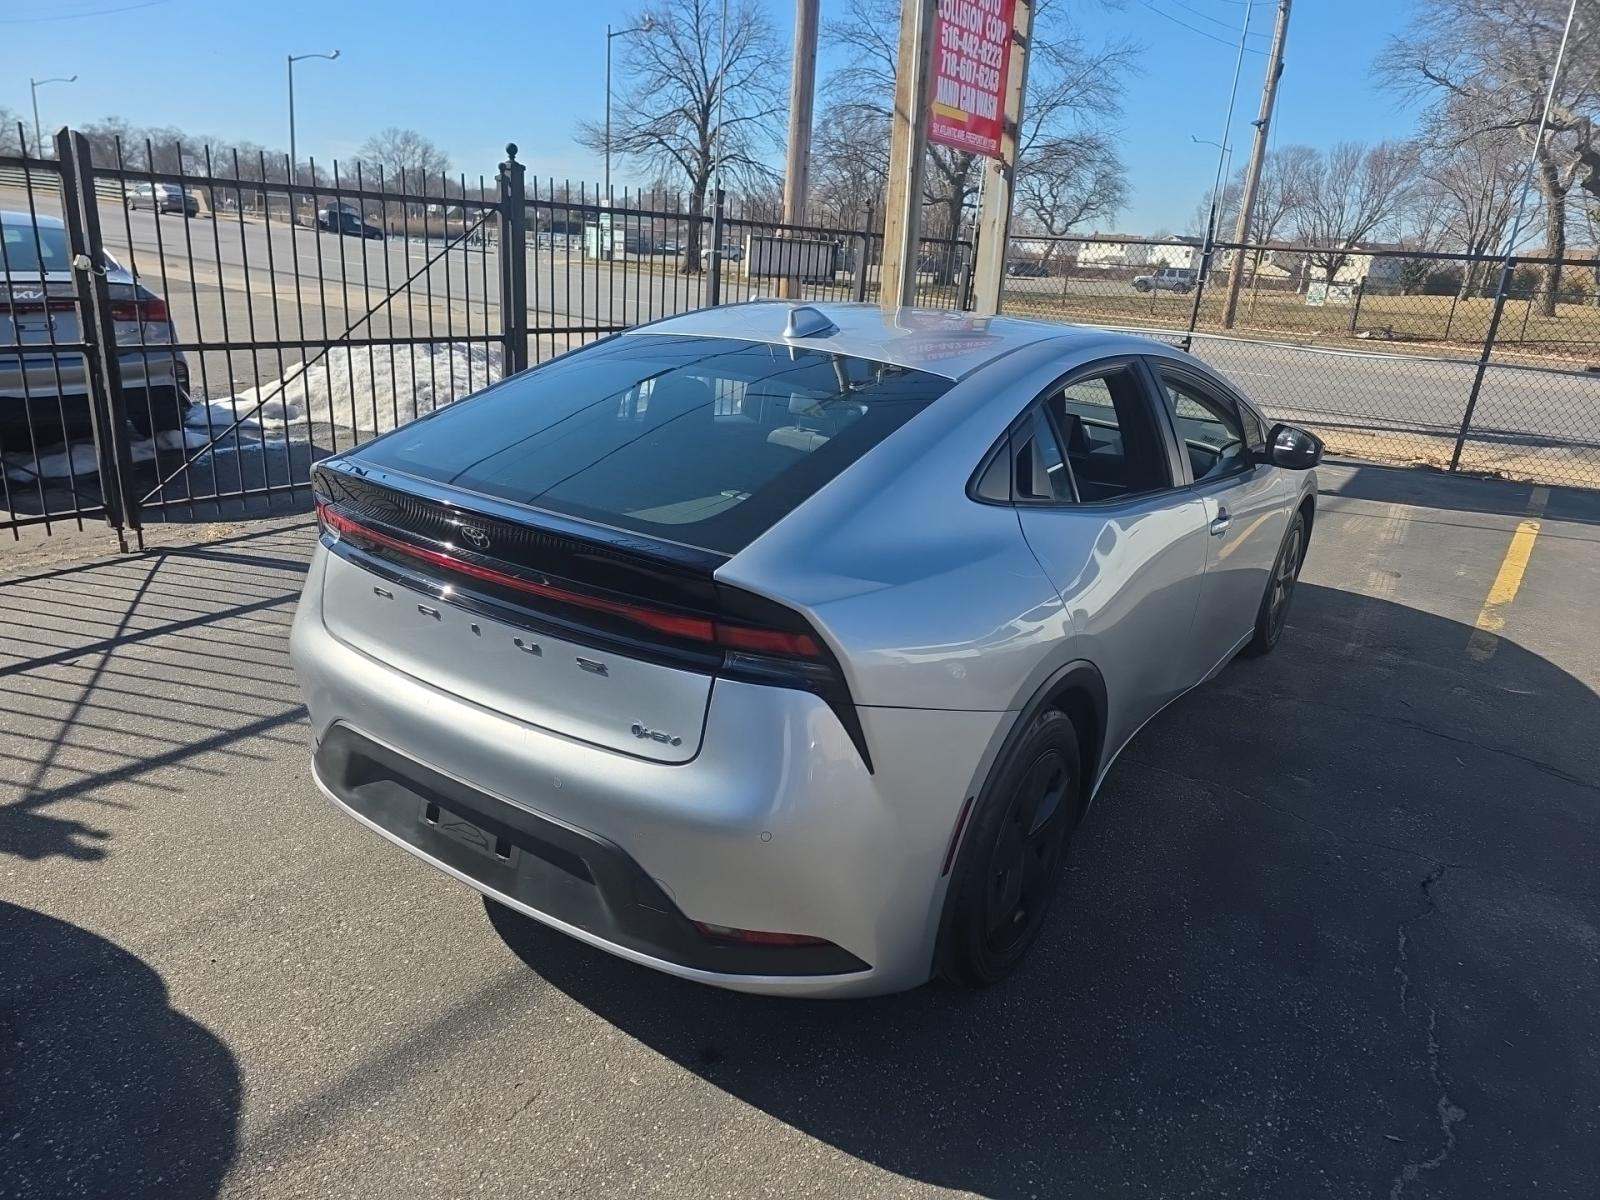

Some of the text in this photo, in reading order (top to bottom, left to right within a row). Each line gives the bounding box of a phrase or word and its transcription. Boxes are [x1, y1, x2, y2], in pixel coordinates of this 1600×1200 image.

[938, 0, 983, 36] COLLISION
[941, 21, 1003, 70] 516-442-8223
[936, 75, 998, 121] HAND CAR WASH
[373, 586, 609, 678] PRIUS
